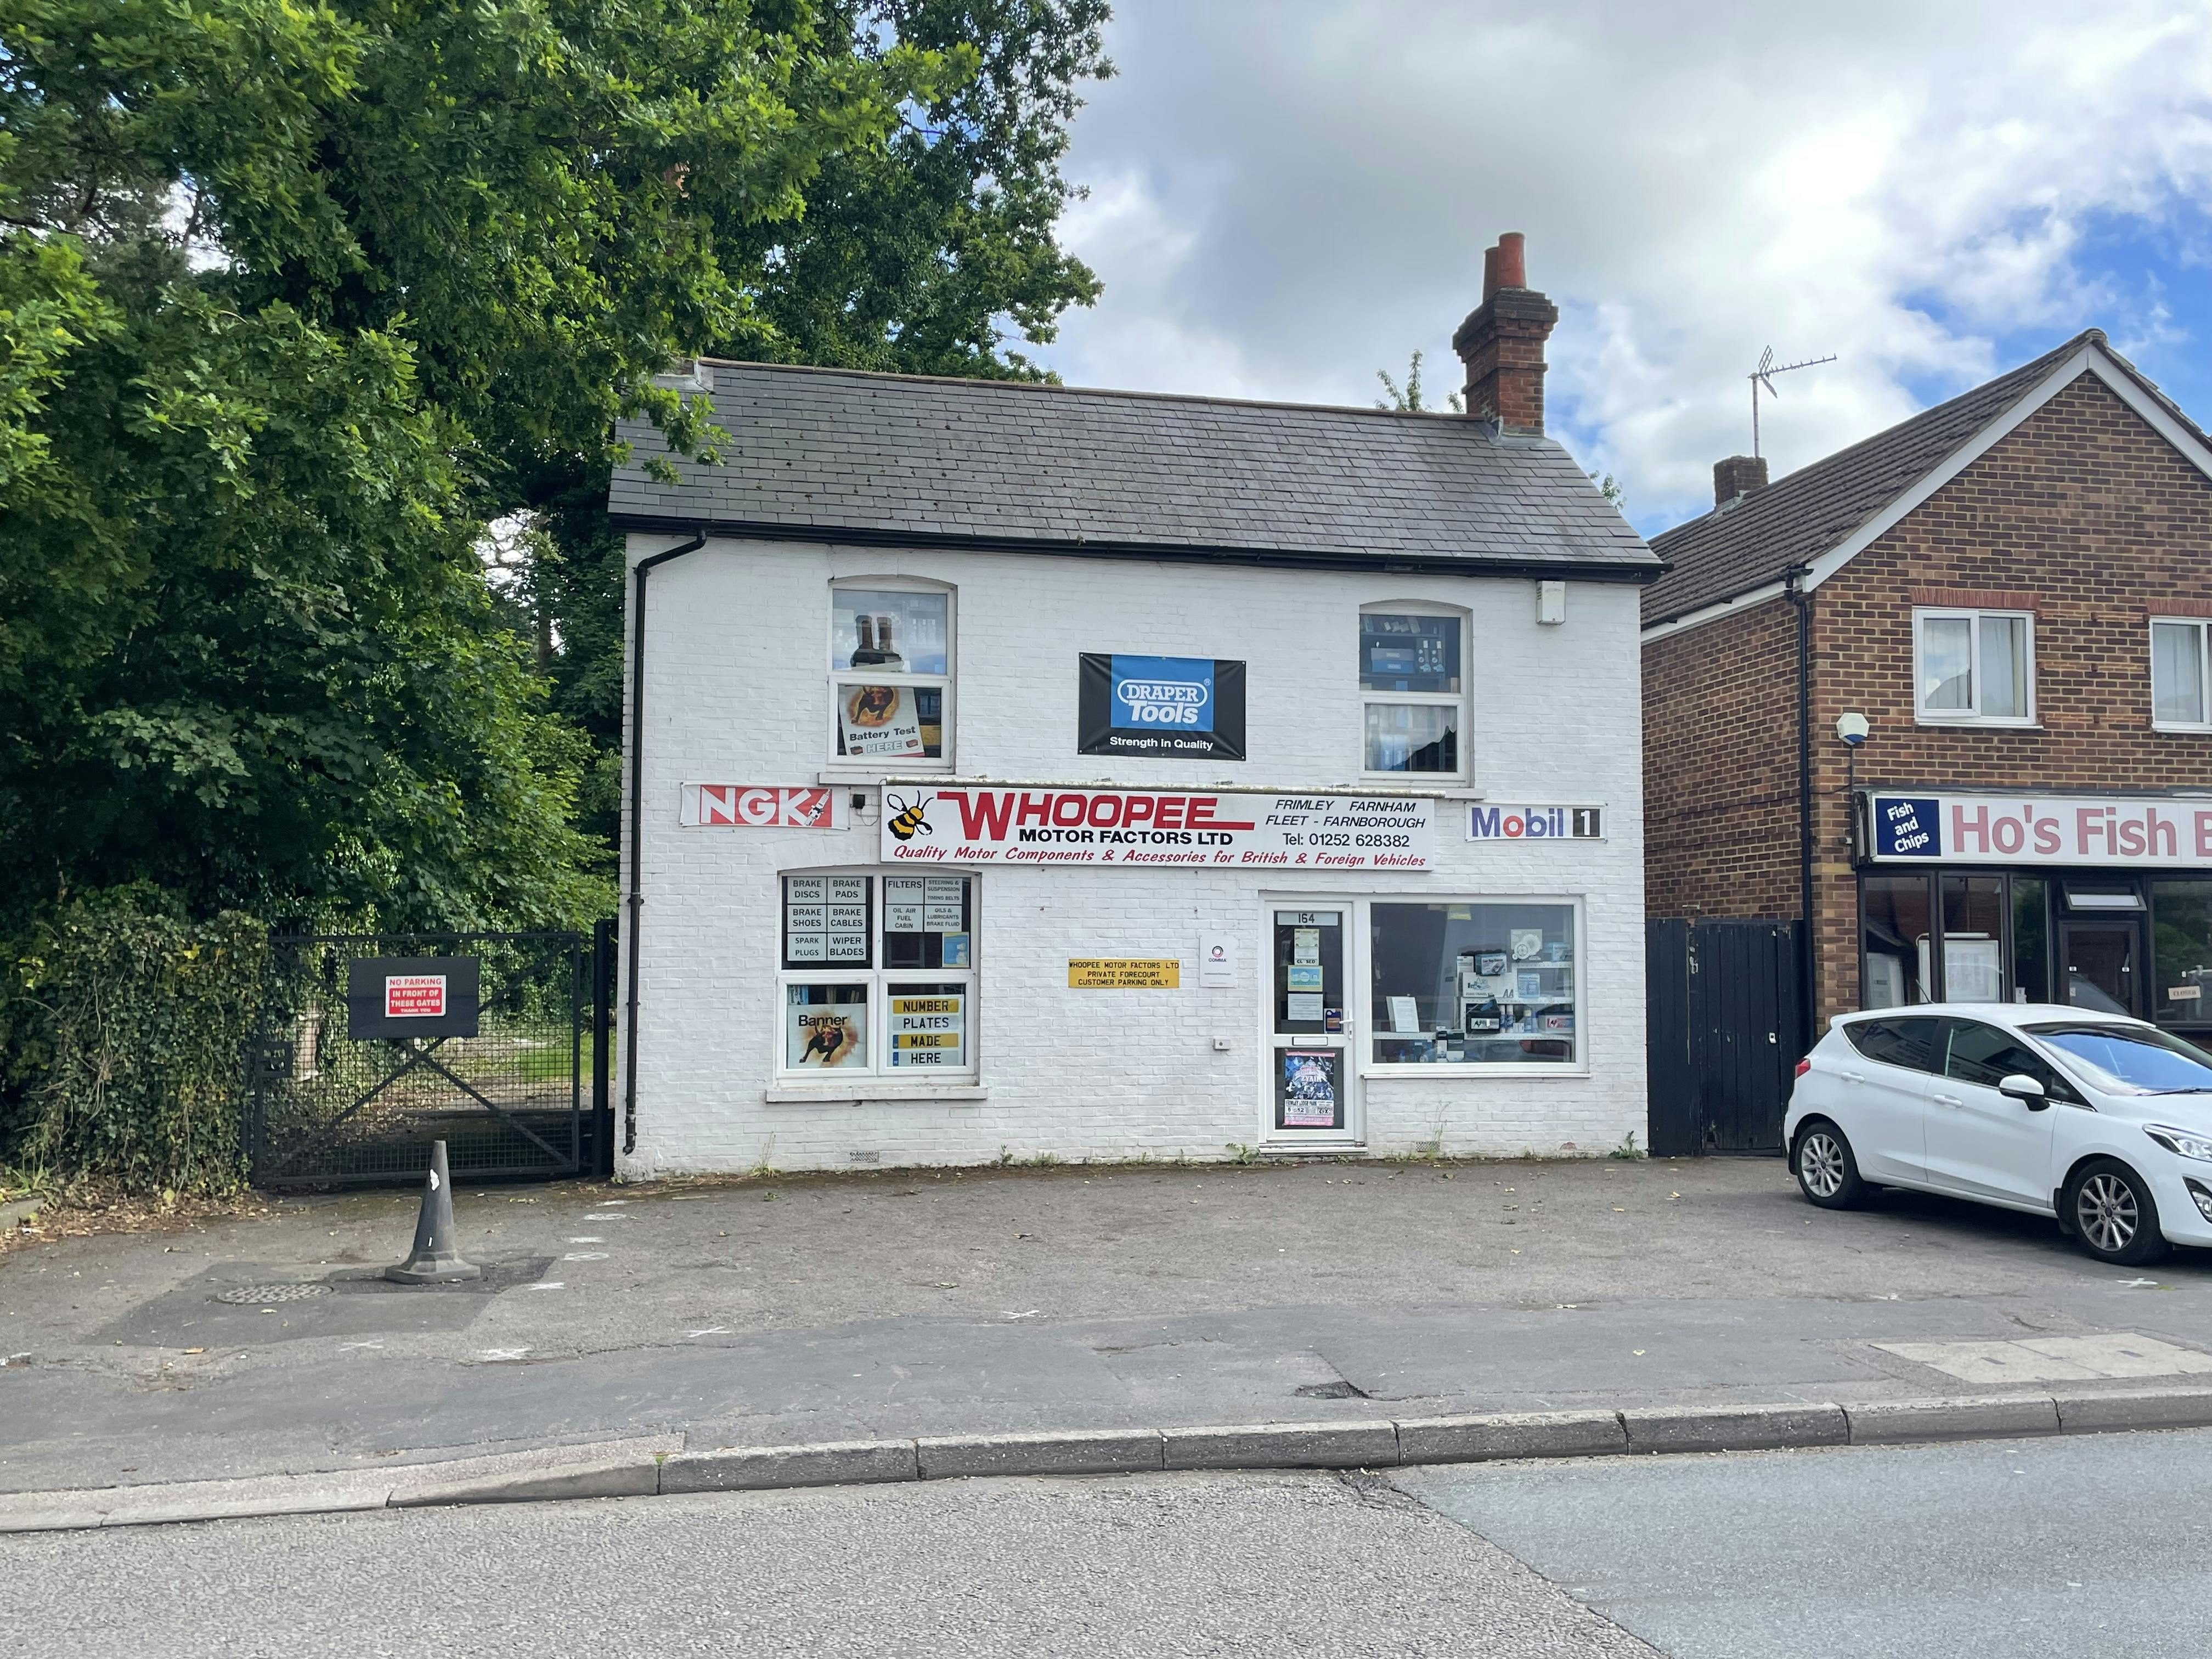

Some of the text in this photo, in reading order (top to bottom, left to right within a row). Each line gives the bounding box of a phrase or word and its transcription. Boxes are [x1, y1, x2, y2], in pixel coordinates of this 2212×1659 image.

[1126, 685, 1199, 702] DRAPER
[1128, 700, 1199, 724] Tools
[849, 726, 916, 741] Battery Test
[866, 740, 902, 753] HERE
[1110, 736, 1158, 748] Strength
[1174, 739, 1214, 751] Quality
[700, 785, 812, 826] NGK
[1275, 799, 1417, 812] FRIMLEY FARNHAM
[1887, 803, 1914, 822] Fish
[937, 791, 1255, 840] WHOOPEE
[1265, 815, 1310, 826] FLEET
[1323, 816, 1425, 828] FARNBOROUGH
[1471, 807, 1591, 837] Mobil 1
[1894, 817, 1918, 837] and
[1951, 804, 2061, 855] Ho's
[2076, 806, 2177, 856] Fish
[1019, 829, 1233, 845] MOTOR FACTORS LTD
[1283, 833, 1410, 847] Tel: 01252 628382
[1894, 832, 1930, 853] Chips
[894, 845, 1426, 867] Quality Motor Components & Accessories for British & Foreign Vehicles
[1299, 913, 1315, 923] 164
[903, 1000, 949, 1012] NUMBER
[798, 1015, 847, 1026] Banner
[903, 1017, 949, 1029] PLATES
[910, 1035, 941, 1047] MADE
[911, 1052, 941, 1064] HERE
